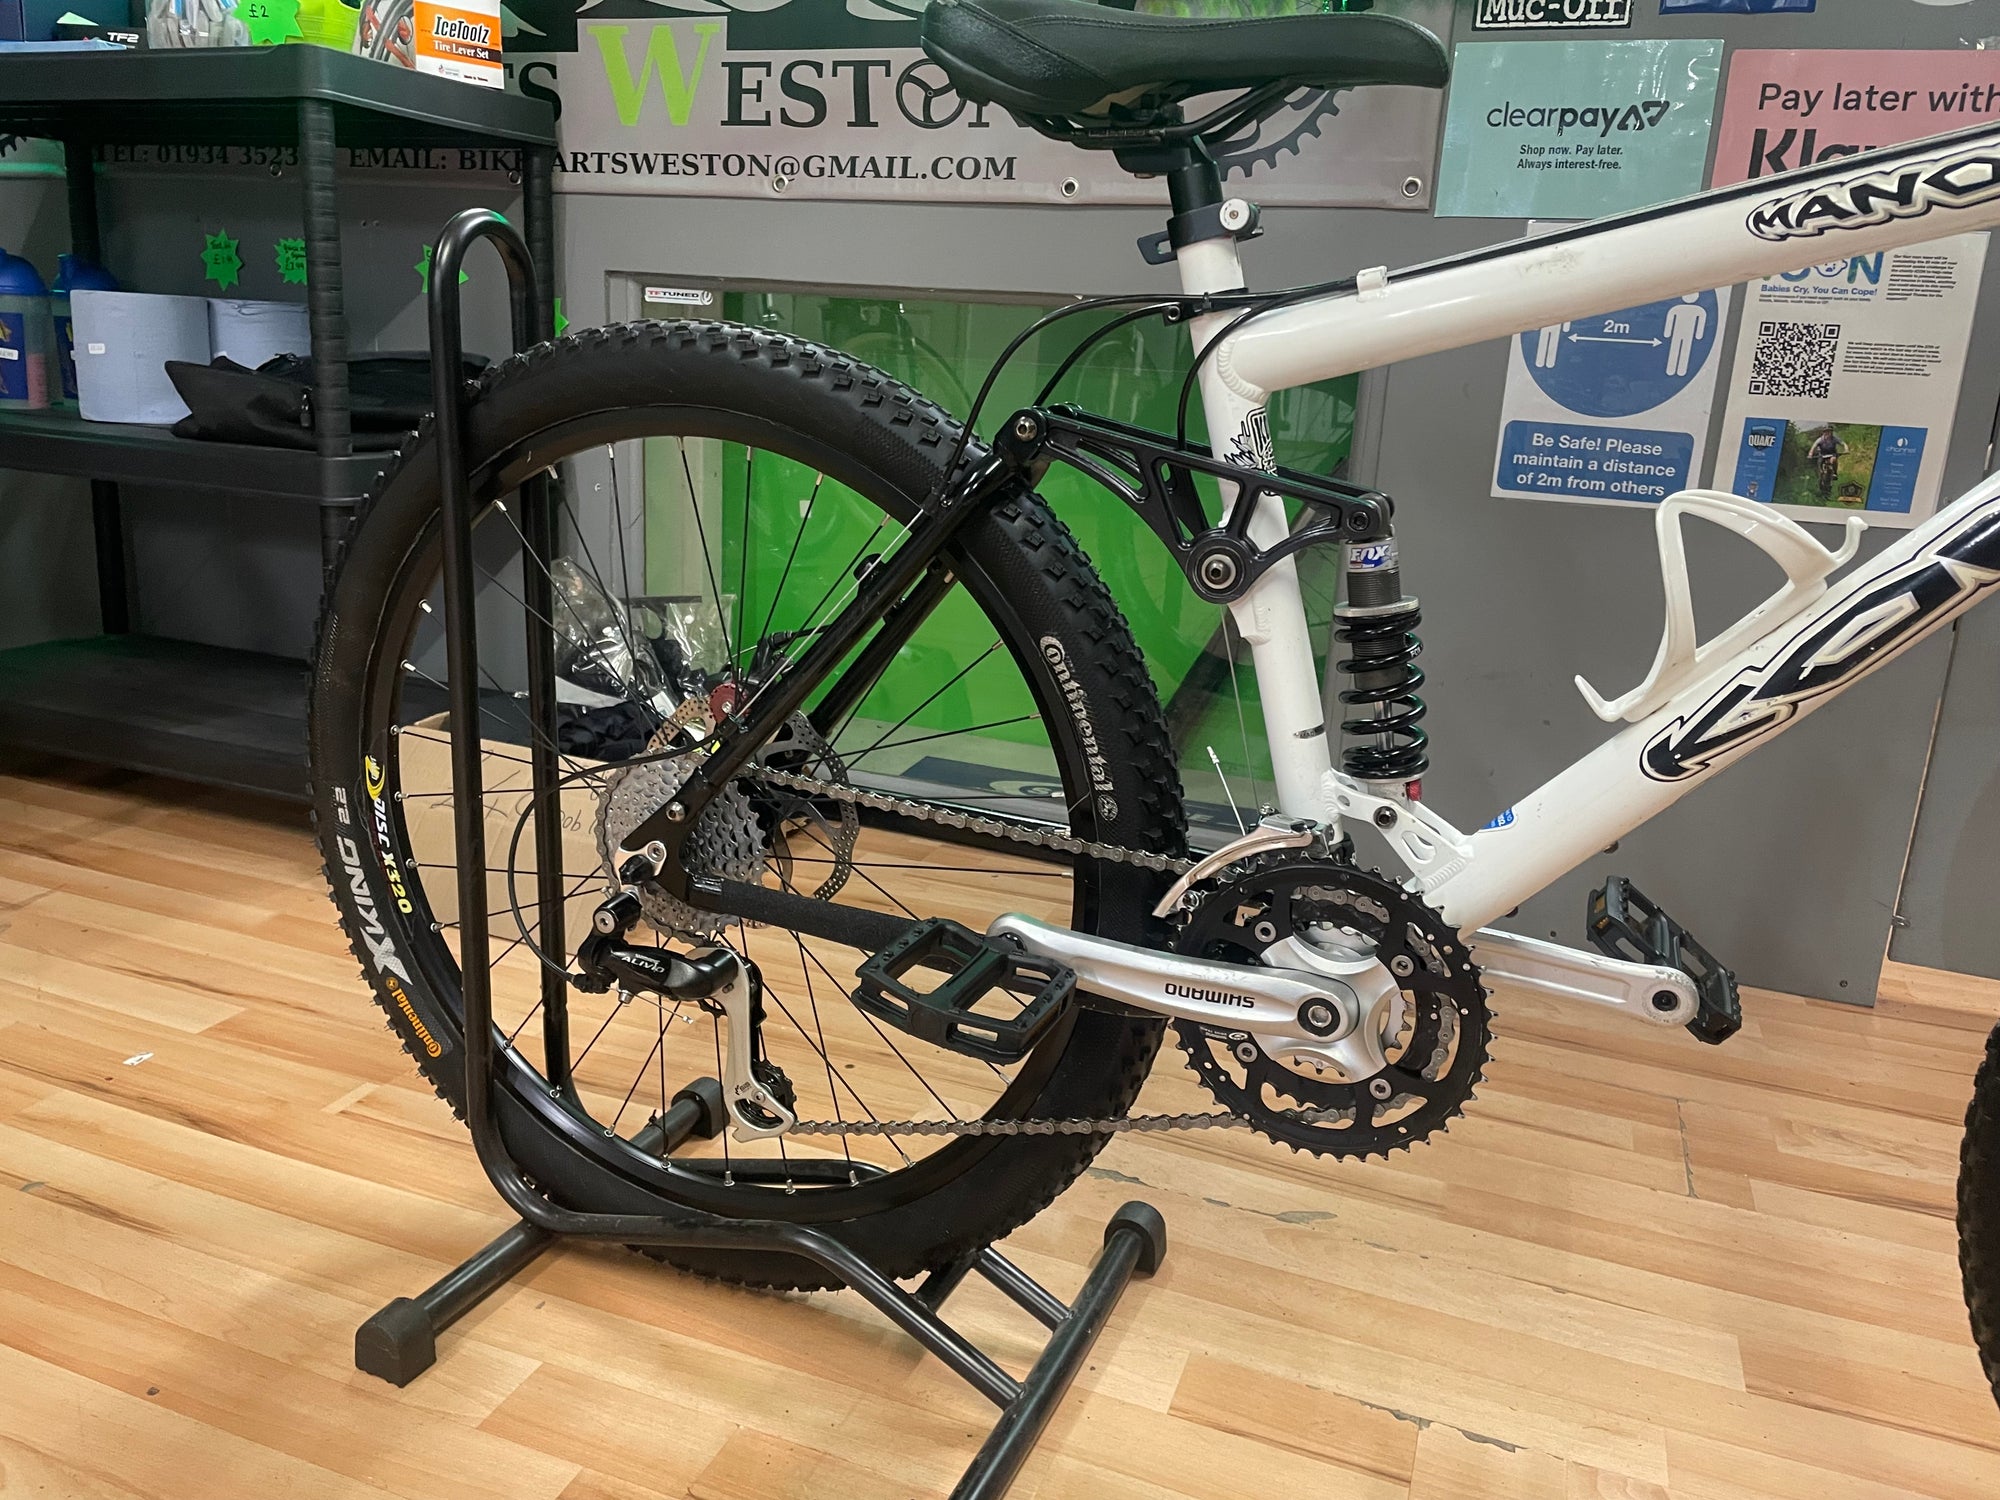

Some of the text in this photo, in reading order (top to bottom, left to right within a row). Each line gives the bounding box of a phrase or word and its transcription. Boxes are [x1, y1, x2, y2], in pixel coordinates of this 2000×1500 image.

[249, 6, 269, 18] £2
[107, 32, 139, 43] TF2
[434, 16, 490, 45] IceToolz
[434, 40, 489, 59] Tire Lever Set
[1758, 82, 1823, 117] Pay
[1833, 82, 1917, 112] later
[1487, 101, 1621, 138] clearpay
[350, 147, 447, 170] EMAIL:
[1519, 144, 1624, 157] Shop now. Pay later.
[1517, 158, 1622, 170] Always interest-free.
[1761, 284, 1791, 293] Babies
[1813, 286, 1830, 295] You
[1832, 287, 1849, 295] Can
[1851, 288, 1878, 297] Cope!
[1603, 320, 1630, 334] 2m
[1532, 433, 1663, 456] Be Safe! Please
[1748, 434, 1777, 447] QUAKE
[1513, 453, 1676, 477] maintain a distance
[1517, 472, 1666, 496] of 2m from others
[1350, 544, 1389, 561] FOX
[1040, 635, 1114, 791] Continental
[373, 798, 391, 848] DISC
[382, 850, 413, 914] X320
[1165, 983, 1255, 1008] SHIMANO
[391, 988, 442, 1058] Continental
